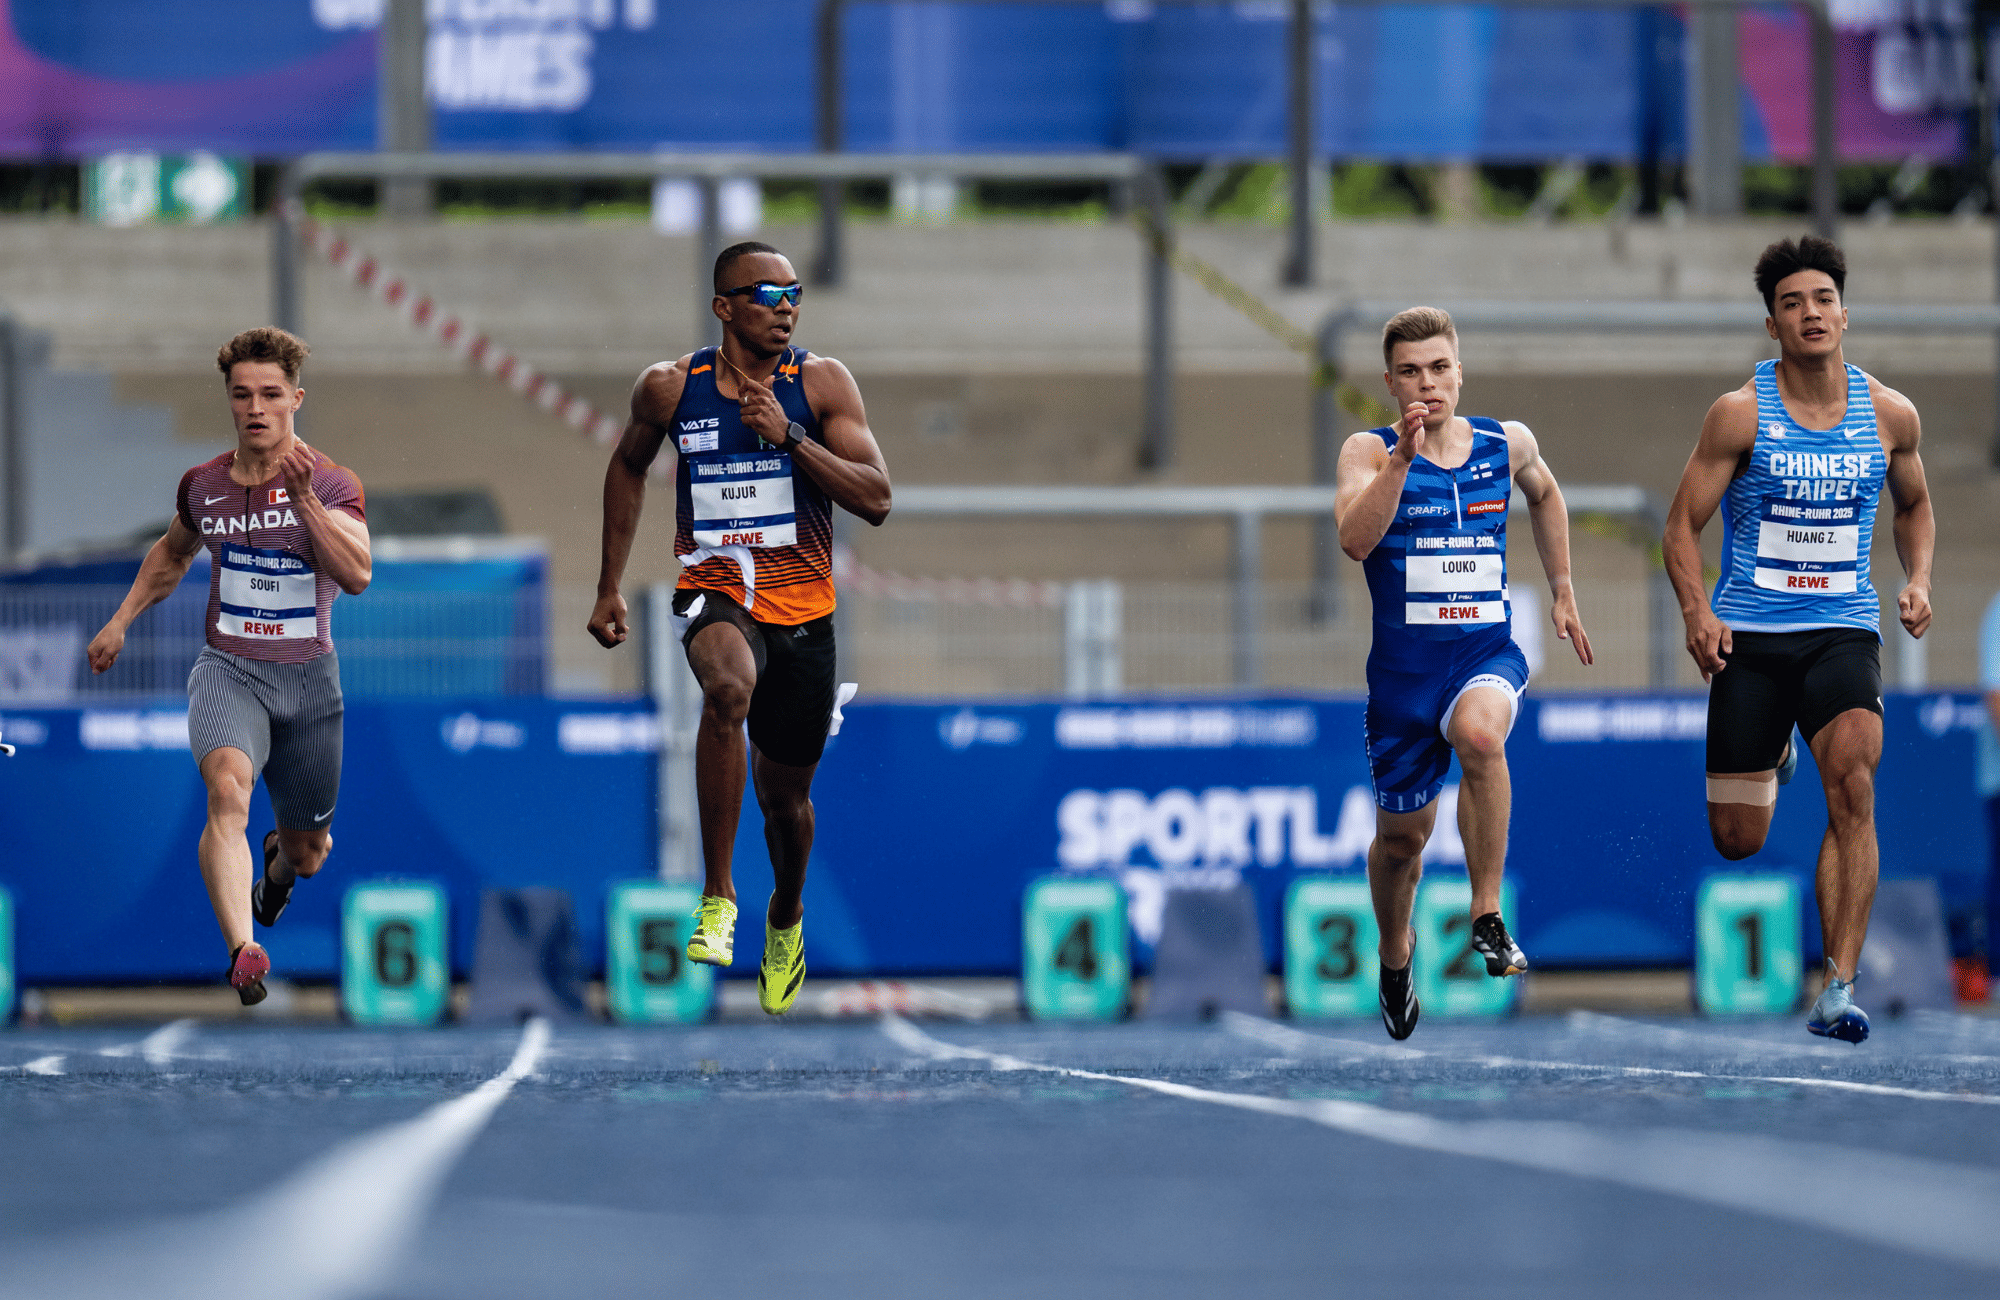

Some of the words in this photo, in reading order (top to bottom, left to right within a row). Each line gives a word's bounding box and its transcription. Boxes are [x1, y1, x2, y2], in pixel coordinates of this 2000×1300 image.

[680, 418, 719, 431] VATS
[697, 461, 754, 476] RHINE-RUHR
[755, 459, 782, 472] 2025
[1770, 453, 1872, 478] CHINESE
[721, 485, 757, 500] KUJUR
[1782, 479, 1859, 501] TAIPEI
[1407, 506, 1443, 516] CRAFT
[1770, 504, 1832, 520] RHINE-RUHR
[1833, 507, 1854, 519] 2025
[201, 509, 298, 535] CANADA
[722, 532, 765, 546] REWE
[1416, 537, 1475, 549] RHINE-RUHR
[1476, 536, 1495, 548] 2025
[1787, 530, 1825, 544] HUANG
[1827, 531, 1837, 544] Z.
[228, 550, 280, 569] RHINE-RUHR
[281, 557, 303, 569] 2025
[1442, 560, 1476, 574] LOUKO
[250, 578, 280, 592] SOUFI
[1787, 575, 1829, 589] REWE
[1438, 606, 1480, 619] REWE
[244, 621, 285, 635] REWE
[1380, 789, 1427, 812] FIN
[640, 917, 681, 987] 5
[1052, 916, 1098, 982] 4
[1316, 912, 1358, 981] 3
[1441, 912, 1484, 982] 2
[1733, 910, 1764, 981] 1
[375, 921, 416, 987] 6
